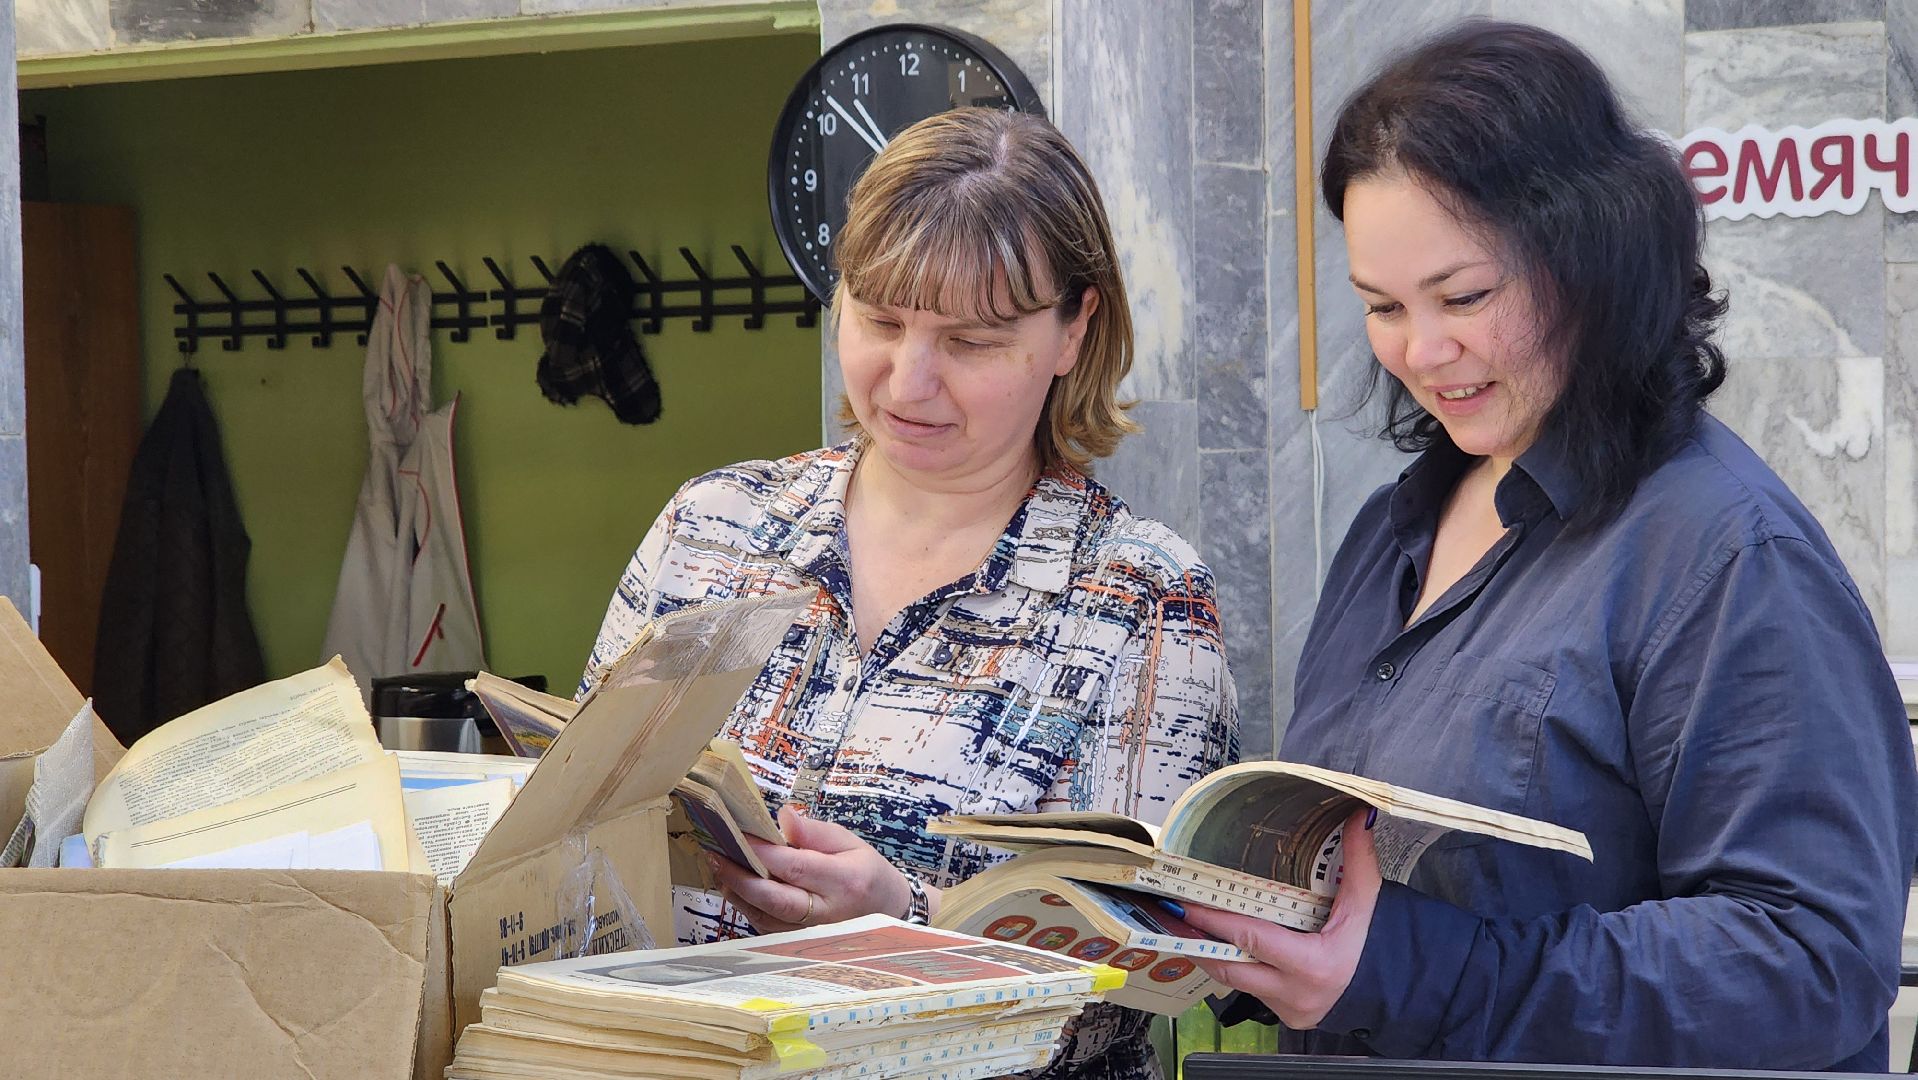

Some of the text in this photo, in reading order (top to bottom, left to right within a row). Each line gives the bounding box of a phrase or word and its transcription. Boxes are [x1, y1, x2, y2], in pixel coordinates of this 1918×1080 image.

[899, 53, 919, 77] 12
[851, 73, 870, 96] 11
[957, 70, 966, 93] 1
[817, 112, 837, 136] 10
[804, 169, 818, 193] 9
[817, 223, 830, 247] 8
